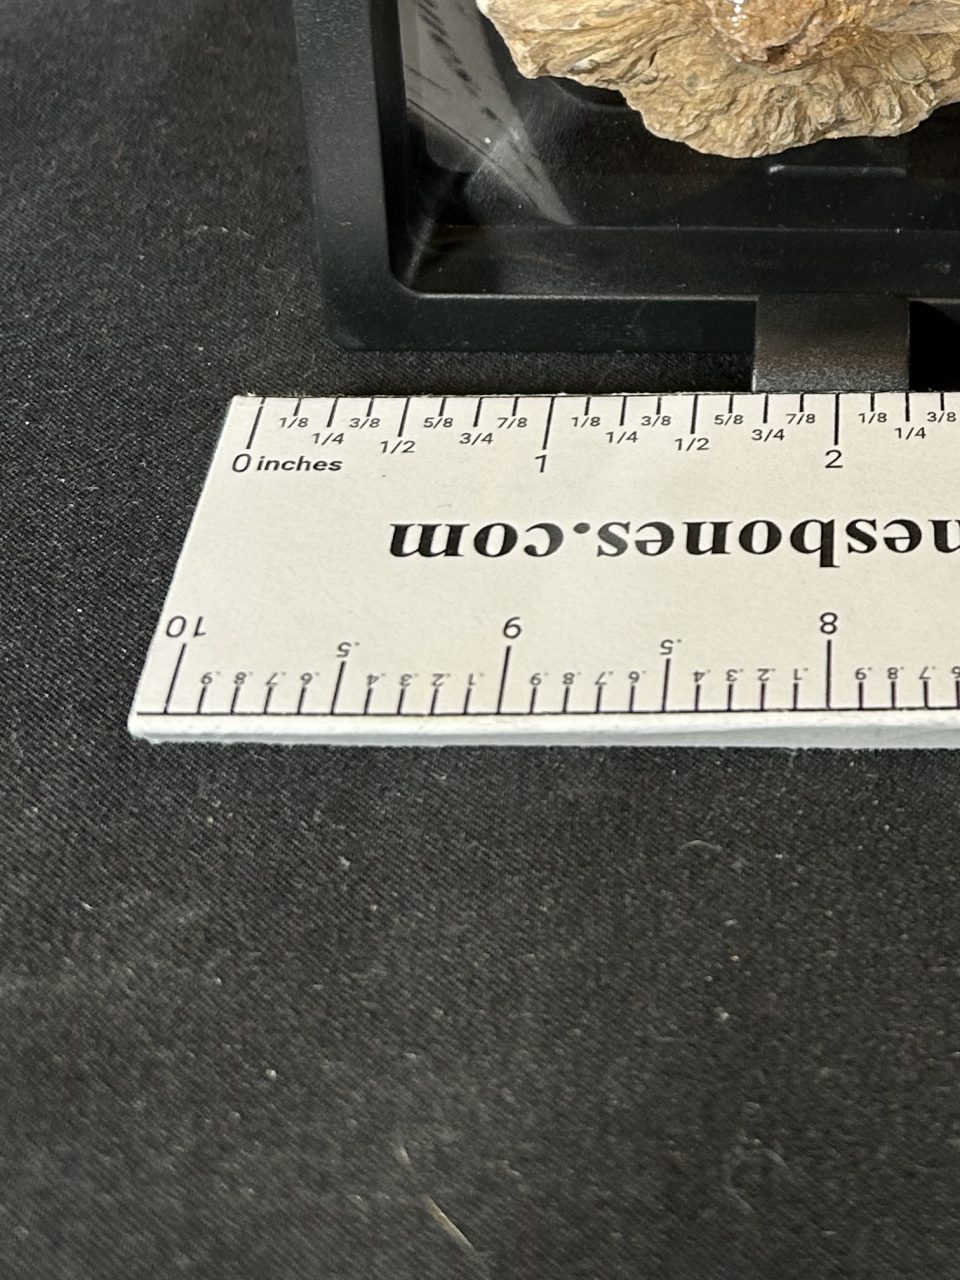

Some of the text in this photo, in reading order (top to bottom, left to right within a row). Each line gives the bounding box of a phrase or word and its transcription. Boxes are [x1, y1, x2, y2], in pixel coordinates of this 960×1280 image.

[280, 417, 308, 428] 1/8
[349, 418, 380, 429] 3/8
[424, 417, 453, 429] 5/8
[498, 417, 527, 429] 7/8
[572, 417, 600, 427] 1/8
[641, 416, 671, 427] 3/8
[714, 415, 743, 426] 5/8
[786, 414, 815, 425] 7/8
[859, 413, 887, 424] 1/8
[927, 412, 956, 423] 3/8
[313, 433, 344, 445] 1/4
[459, 433, 493, 445] 3/4
[606, 431, 638, 444] 1/4
[752, 429, 785, 442] 3/4
[895, 427, 926, 440] 1/4
[381, 440, 415, 454] 1/2
[675, 438, 709, 451] 1/2
[232, 454, 342, 472] 0 inches
[535, 455, 547, 473] 1
[825, 450, 843, 468] 2
[166, 616, 206, 638] 10
[503, 617, 522, 639] 9
[820, 612, 838, 635] 8
